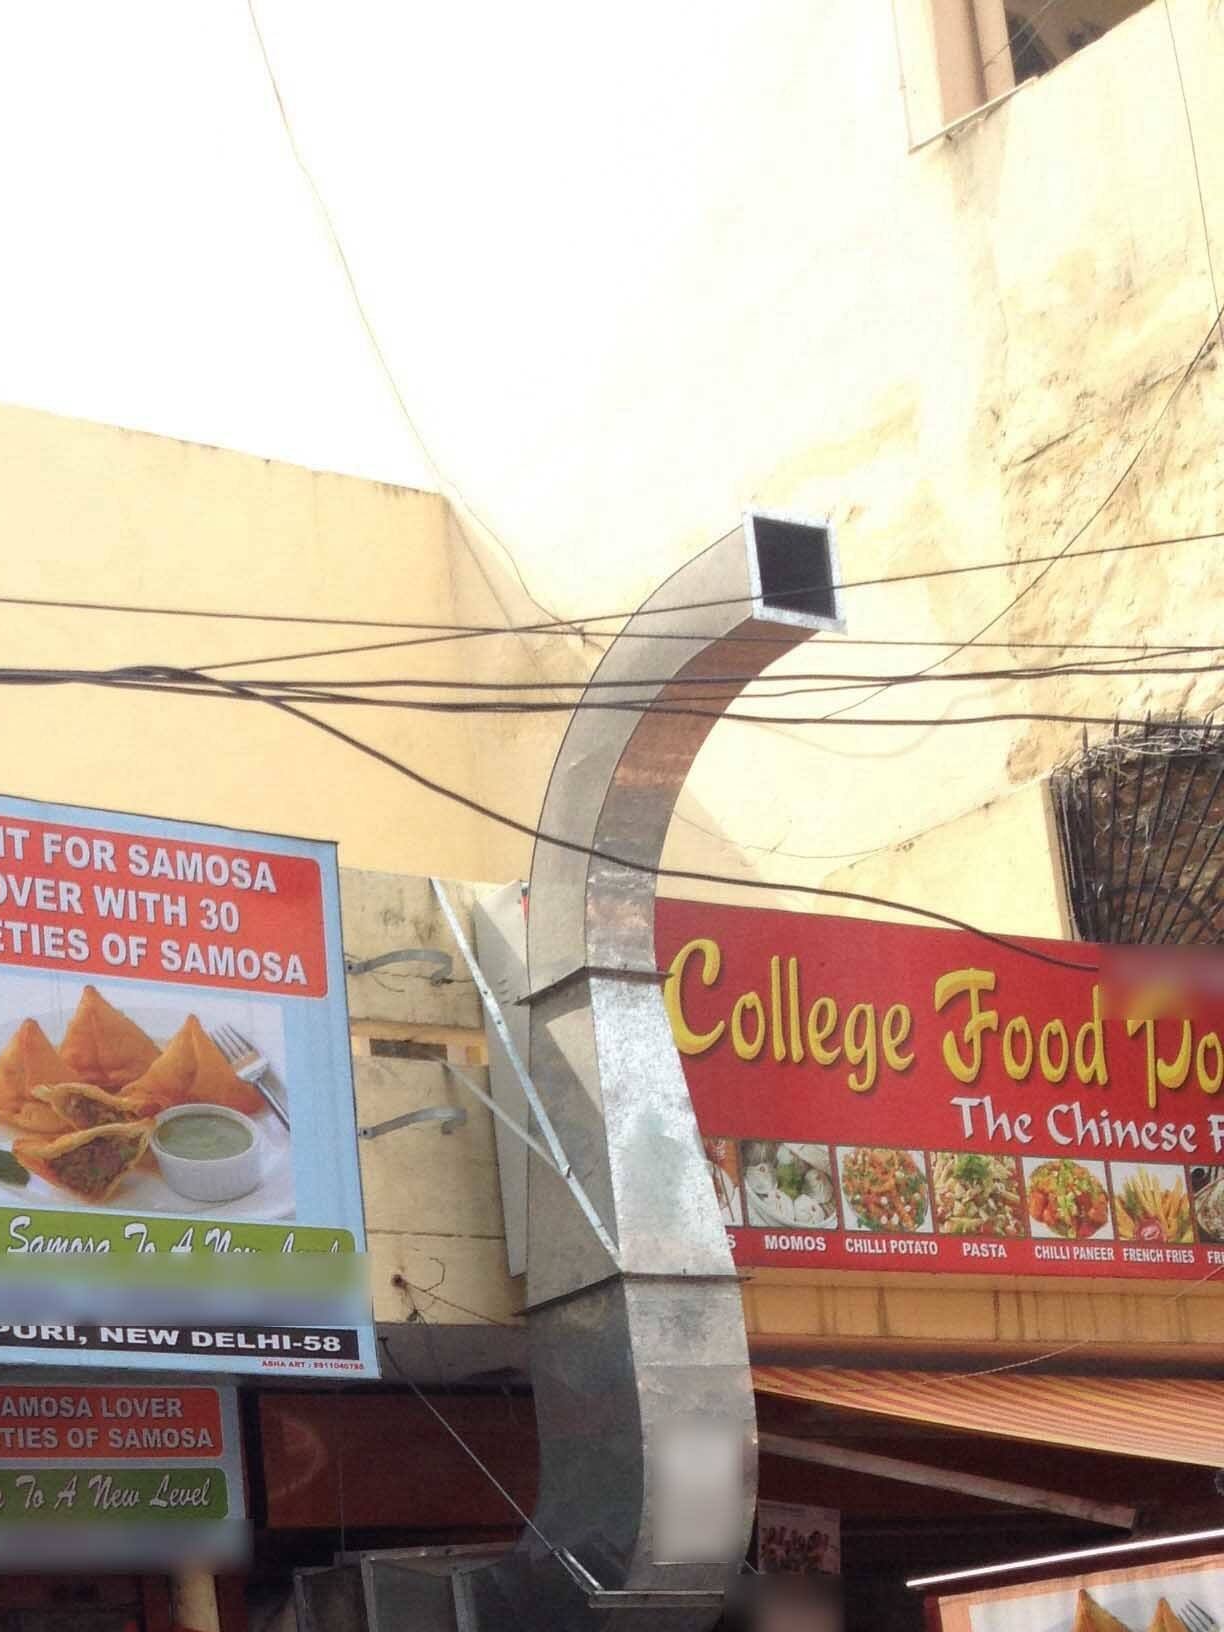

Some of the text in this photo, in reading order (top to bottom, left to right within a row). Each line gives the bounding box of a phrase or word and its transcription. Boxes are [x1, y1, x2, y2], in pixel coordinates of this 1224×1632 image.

[43, 833, 116, 873] FOR
[128, 842, 276, 893] SAMOSA
[93, 885, 187, 928] WITH
[200, 899, 239, 934] 30
[101, 932, 147, 967] OF
[160, 943, 307, 985] SAMOSA
[663, 937, 915, 1092] College
[933, 967, 1109, 1086] Food
[951, 1095, 1033, 1143] The
[1046, 1102, 1198, 1154] Chinese
[764, 1234, 827, 1251] MOMOS
[845, 1237, 939, 1256] CHILLI POTATO
[962, 1242, 1008, 1258] PASTA
[1034, 1245, 1115, 1261] CHILLI PANEER
[1123, 1248, 1195, 1264] FRENCH FRIES
[100, 1326, 180, 1347] NEW
[191, 1331, 341, 1352] DELHI-58
[100, 1396, 182, 1418] LOVER
[67, 1428, 99, 1448] OF
[108, 1428, 214, 1449] SAMOSA
[15, 1474, 43, 1510] To
[54, 1475, 77, 1510] A
[87, 1475, 139, 1510] New
[149, 1474, 210, 1510] Level
